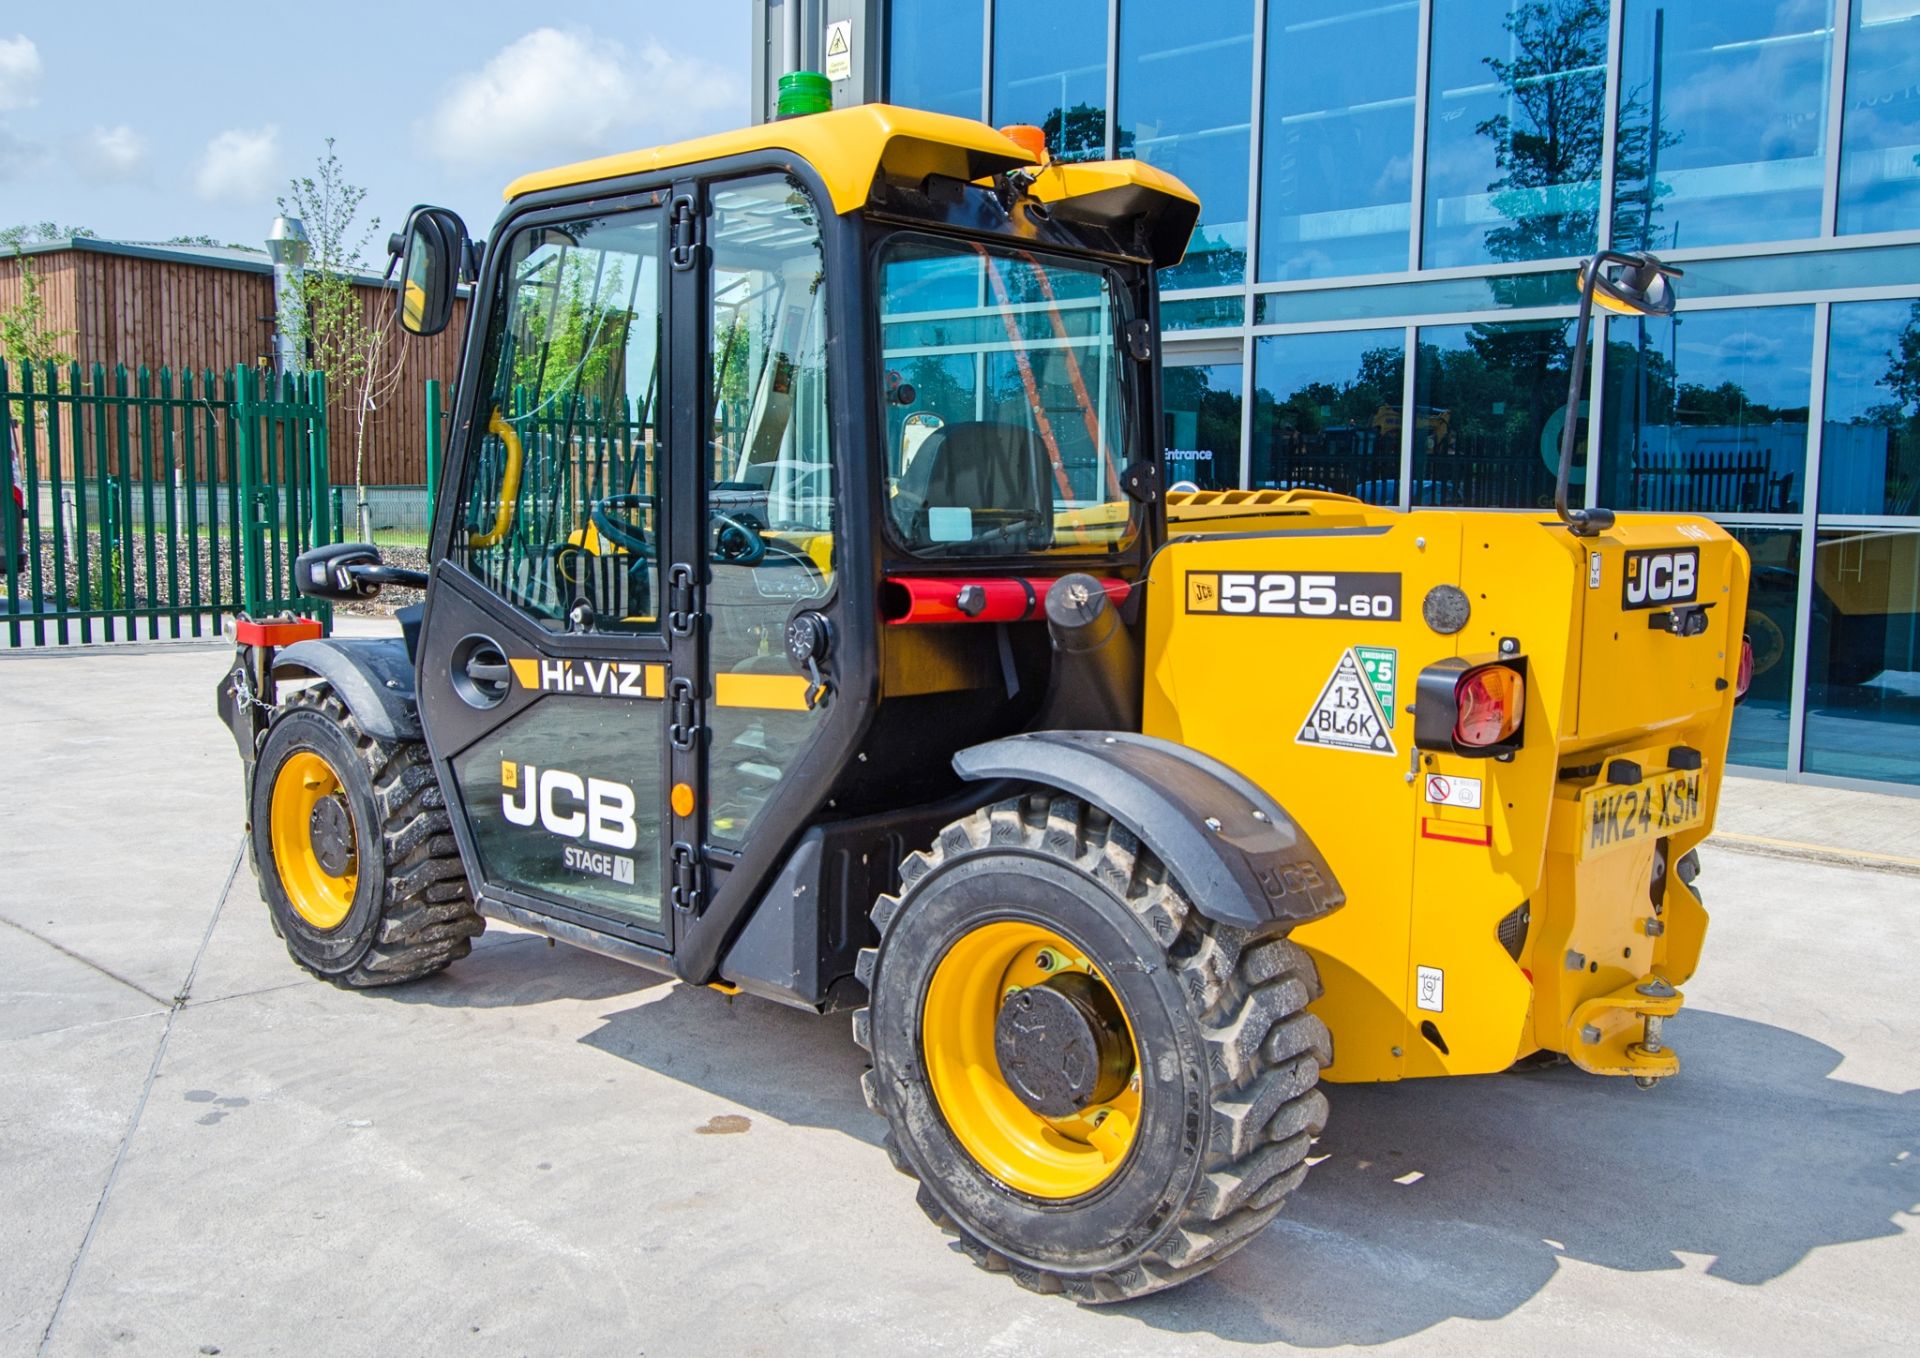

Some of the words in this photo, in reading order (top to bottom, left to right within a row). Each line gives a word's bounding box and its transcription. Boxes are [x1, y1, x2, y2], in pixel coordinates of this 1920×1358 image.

[1220, 574, 1393, 617] 525-60
[1627, 552, 1697, 603] JCB
[1377, 662, 1392, 681] 5
[1335, 686, 1360, 709] 13
[1319, 709, 1373, 737] BL6K
[502, 764, 637, 850] JCB
[1590, 788, 1652, 849] MK24
[1658, 774, 1700, 829] XSN
[565, 847, 612, 876] STAGE
[1260, 861, 1324, 899] JCB
